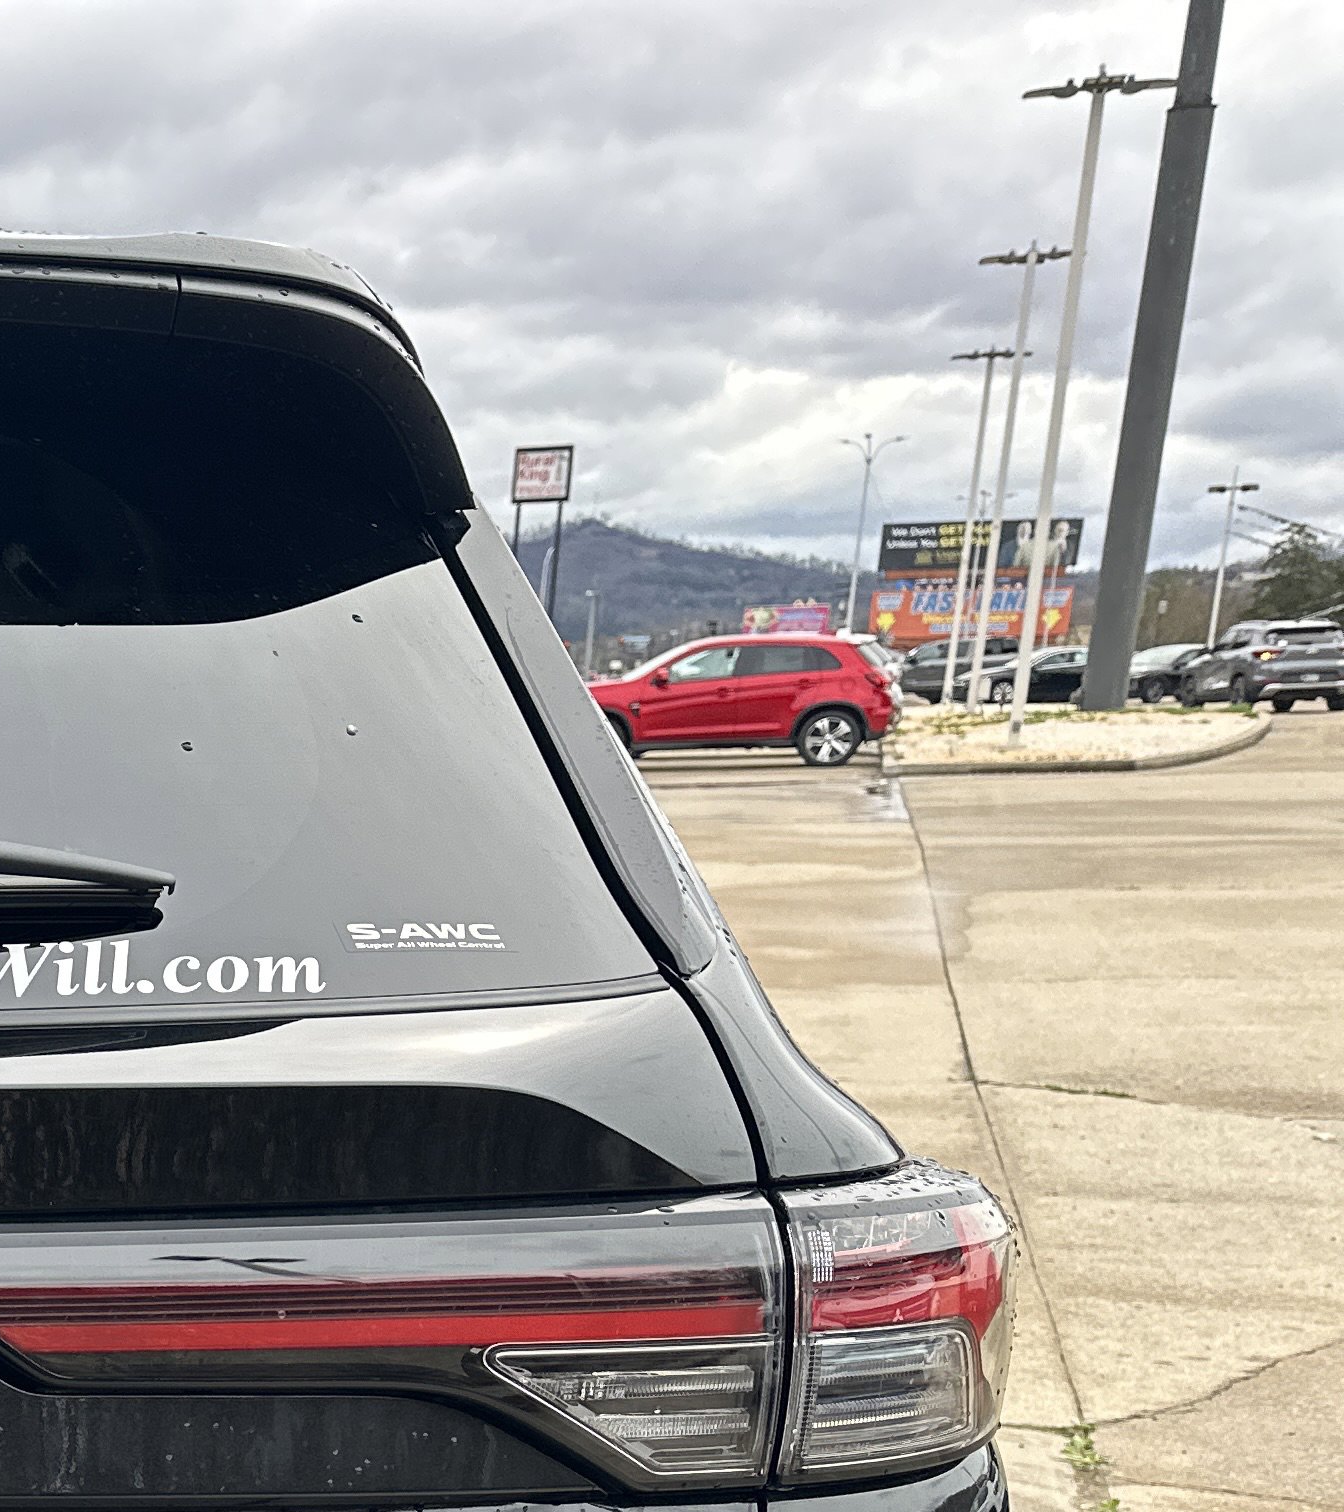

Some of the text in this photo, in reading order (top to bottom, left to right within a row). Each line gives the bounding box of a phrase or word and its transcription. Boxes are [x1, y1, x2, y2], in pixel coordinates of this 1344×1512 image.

[346, 922, 501, 940] S-AWC
[355, 942, 394, 950] Super
[458, 941, 505, 949] Control
